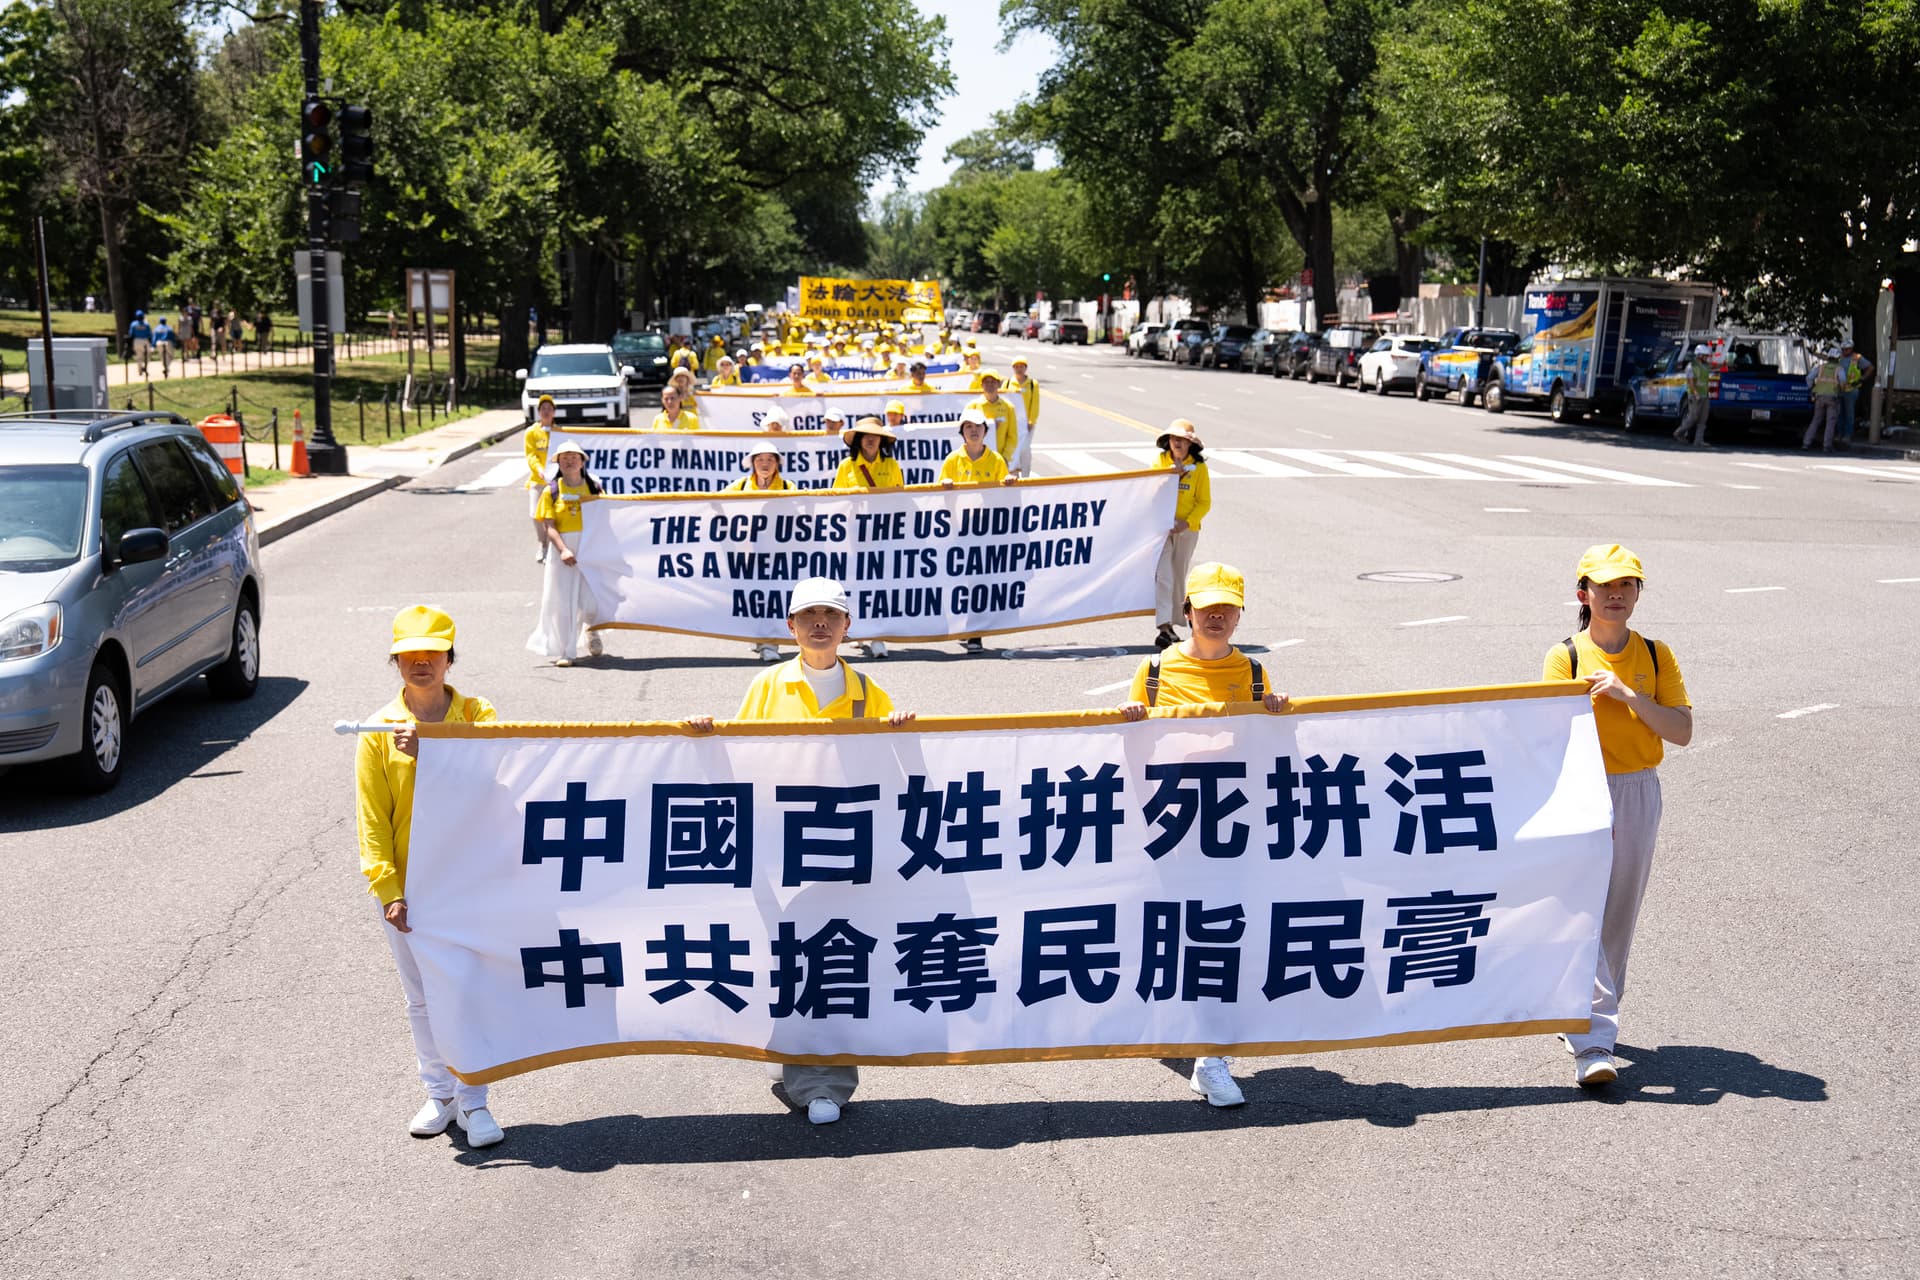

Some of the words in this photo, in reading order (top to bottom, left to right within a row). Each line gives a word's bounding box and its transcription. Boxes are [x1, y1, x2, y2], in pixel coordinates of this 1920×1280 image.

[805, 304, 841, 318] Falun
[846, 306, 880, 318] Dafa
[885, 306, 896, 318] is
[584, 448, 620, 469] THE
[625, 448, 665, 470] CCP
[672, 449, 809, 473] MANIPUES
[893, 439, 953, 461] MEDIA
[599, 476, 625, 495] TO
[631, 477, 710, 495] SPREAD
[901, 468, 935, 485] ND
[650, 516, 701, 545] THE
[709, 514, 768, 543] CCP
[775, 514, 847, 543] USES
[856, 511, 906, 542] THE
[914, 509, 952, 539] US
[958, 499, 1107, 538] JUDICIARY
[658, 553, 694, 578] AS
[702, 552, 721, 578] A
[727, 551, 847, 580] WEAPON
[856, 549, 885, 581] IN
[893, 548, 937, 579] ITS
[946, 536, 1094, 577] CAMPAIGN
[732, 589, 851, 619] AGAI
[858, 587, 942, 619] FALUN
[951, 581, 1026, 615] GONG
[521, 749, 1498, 892] 中國百姓拼死拼活
[519, 889, 1498, 1020] 中共搶奪民脂民膏
